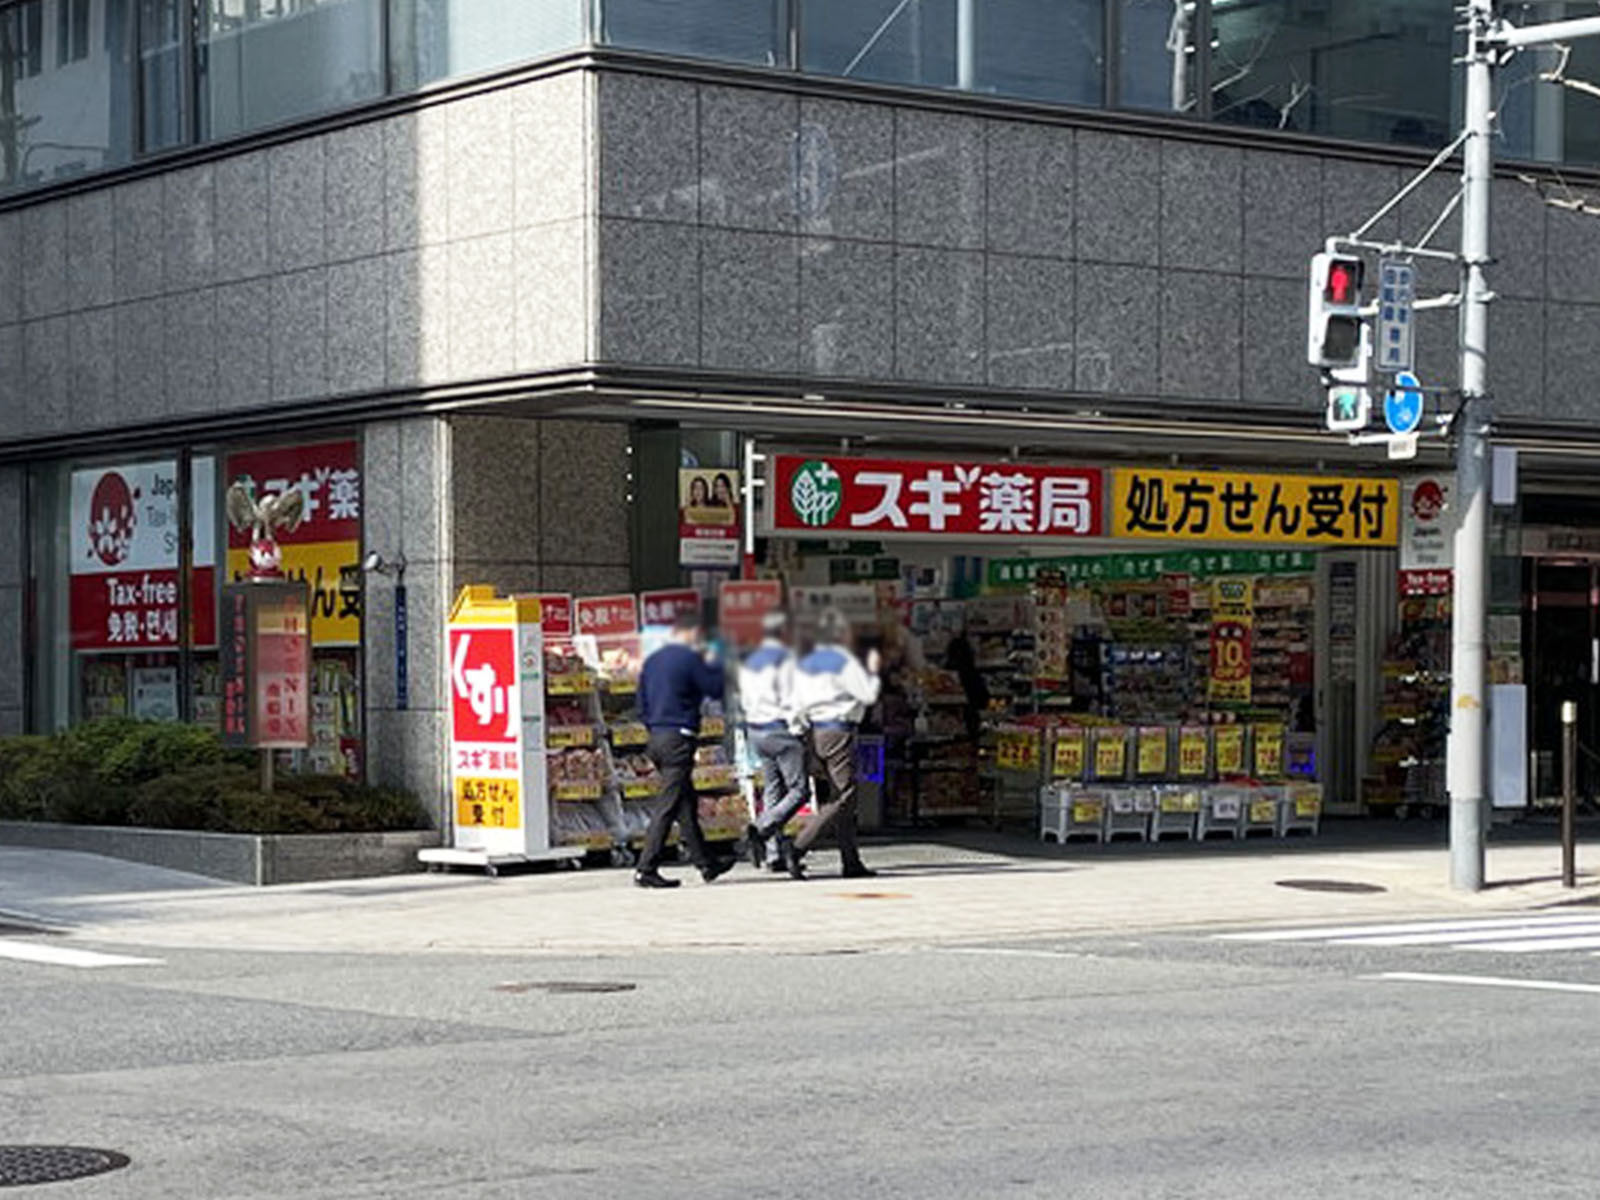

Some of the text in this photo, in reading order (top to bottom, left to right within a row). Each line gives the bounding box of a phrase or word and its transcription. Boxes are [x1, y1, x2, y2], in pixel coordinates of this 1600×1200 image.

[152, 474, 179, 499] Jap
[850, 465, 1091, 533] スギ薬局
[1126, 475, 1389, 539] 処方せん受付
[106, 574, 177, 606] Tax-free
[453, 633, 518, 738] くすり
